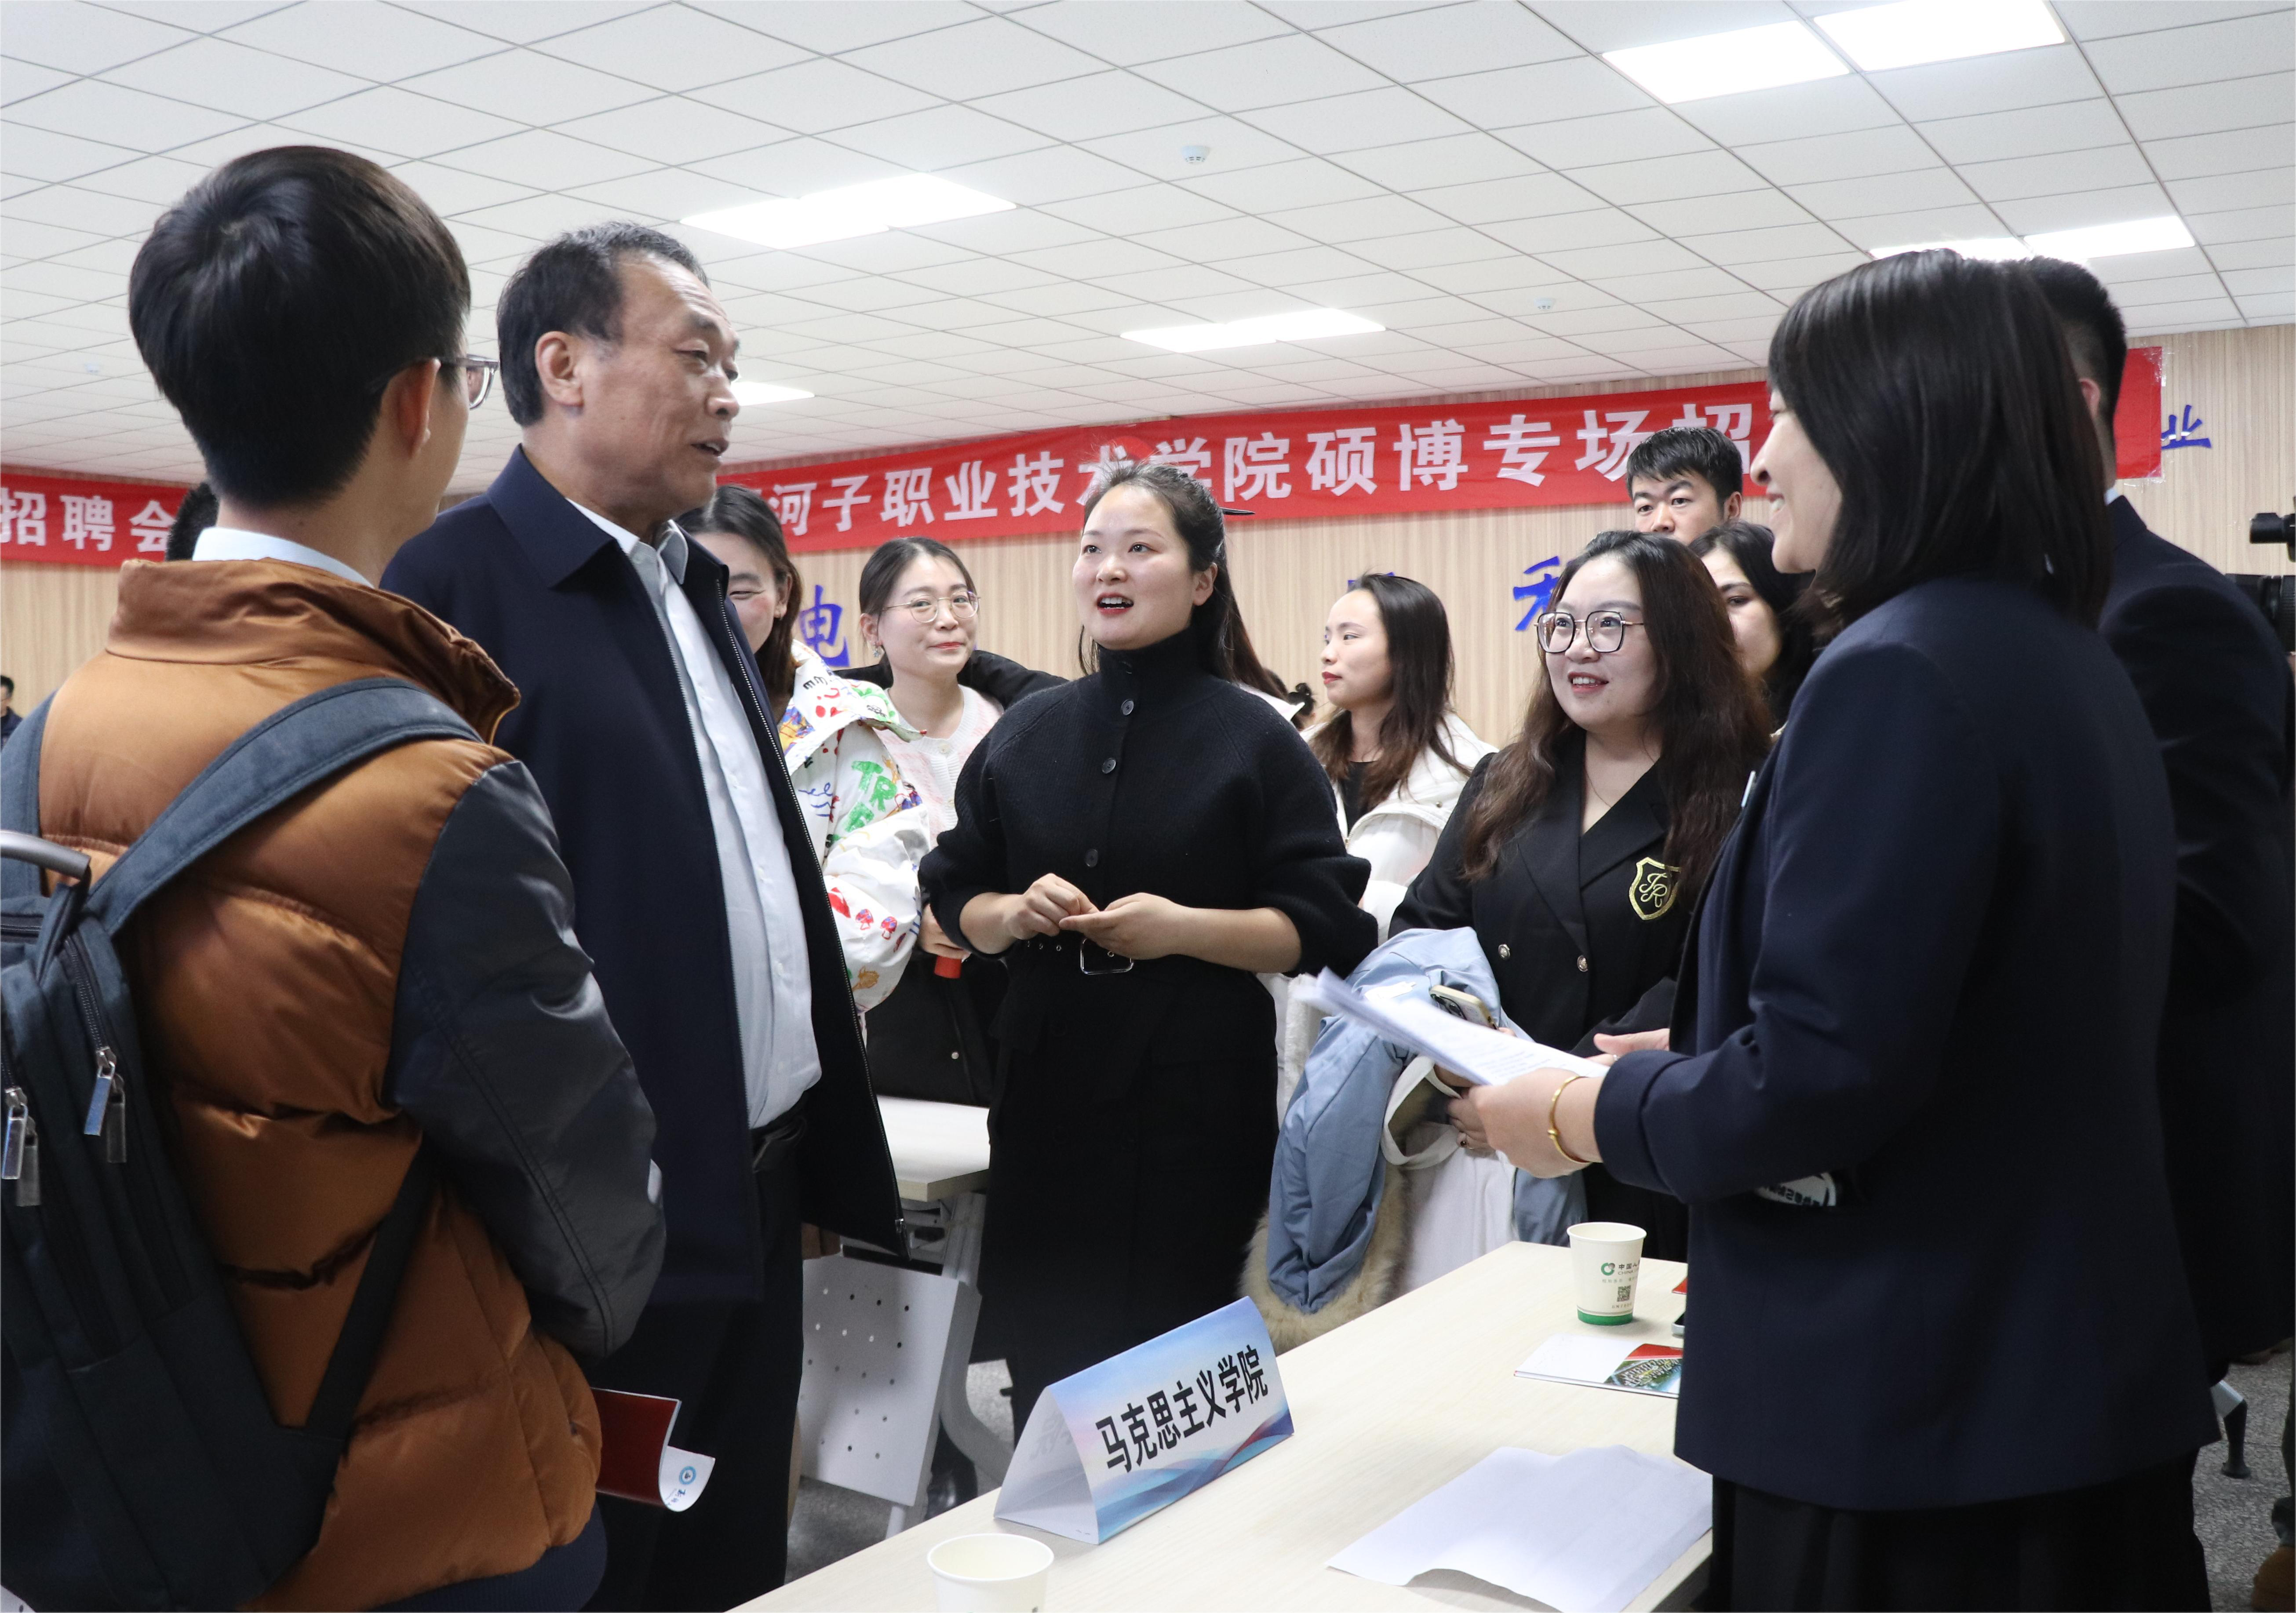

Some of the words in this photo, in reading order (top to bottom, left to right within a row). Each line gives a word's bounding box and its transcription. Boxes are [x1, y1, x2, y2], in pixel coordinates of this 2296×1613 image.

[751, 404, 1753, 536] 河子职业技术学院硕博专场招
[0, 487, 177, 553] 招聘会
[799, 585, 850, 667] 电
[1618, 1260, 1640, 1270] 中国人
[1095, 1344, 1268, 1474] 马克思主义学院
